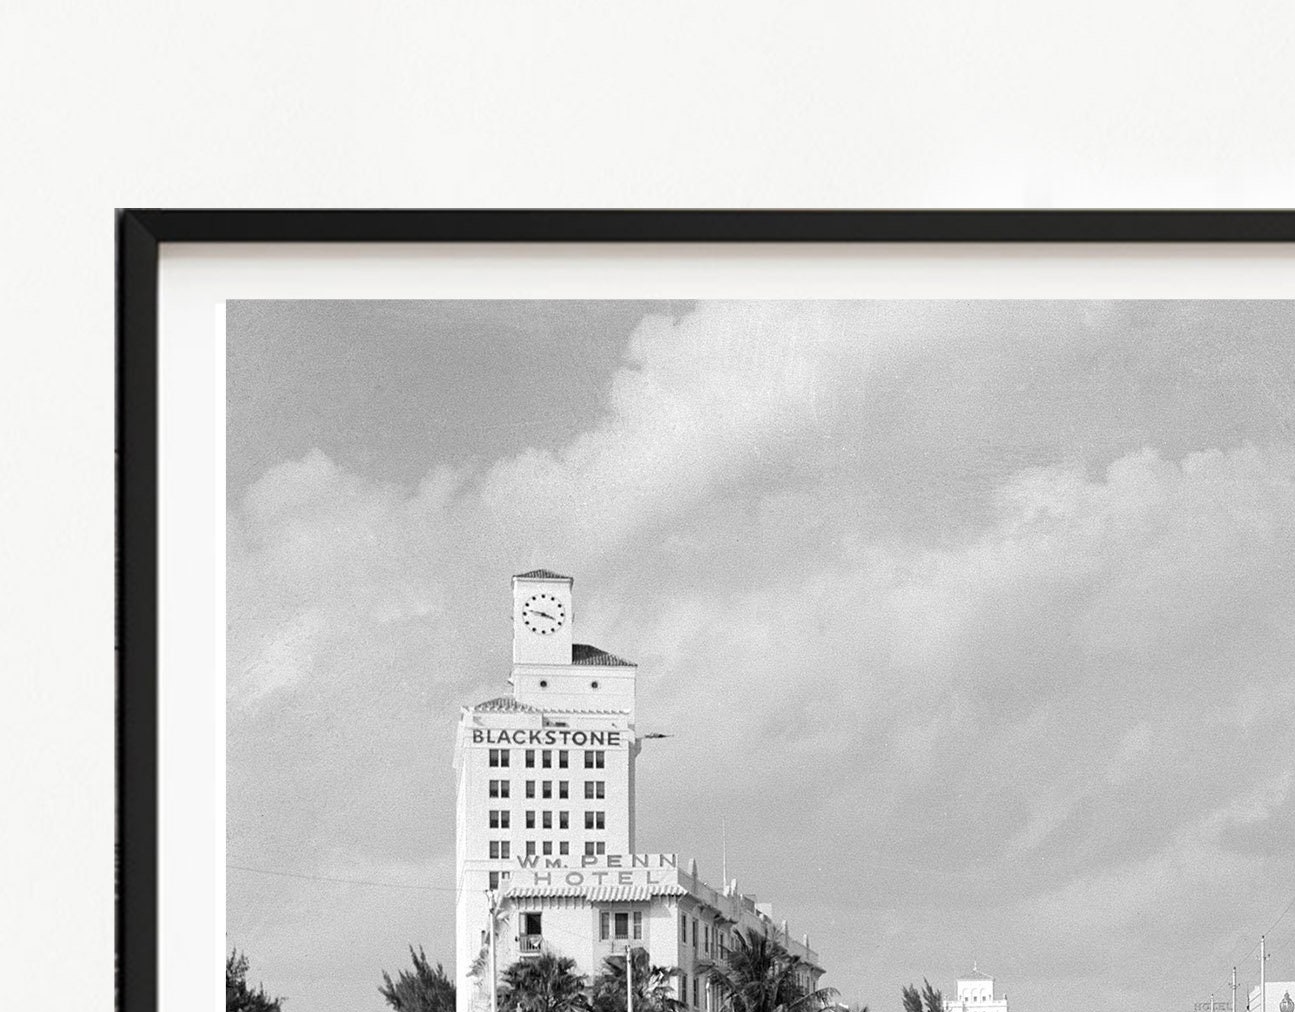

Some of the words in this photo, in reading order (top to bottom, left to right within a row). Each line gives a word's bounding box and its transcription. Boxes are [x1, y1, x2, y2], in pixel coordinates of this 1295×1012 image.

[472, 729, 621, 746] BLACKSTONE
[581, 854, 677, 868] PENN
[534, 871, 660, 886] HOTEL
